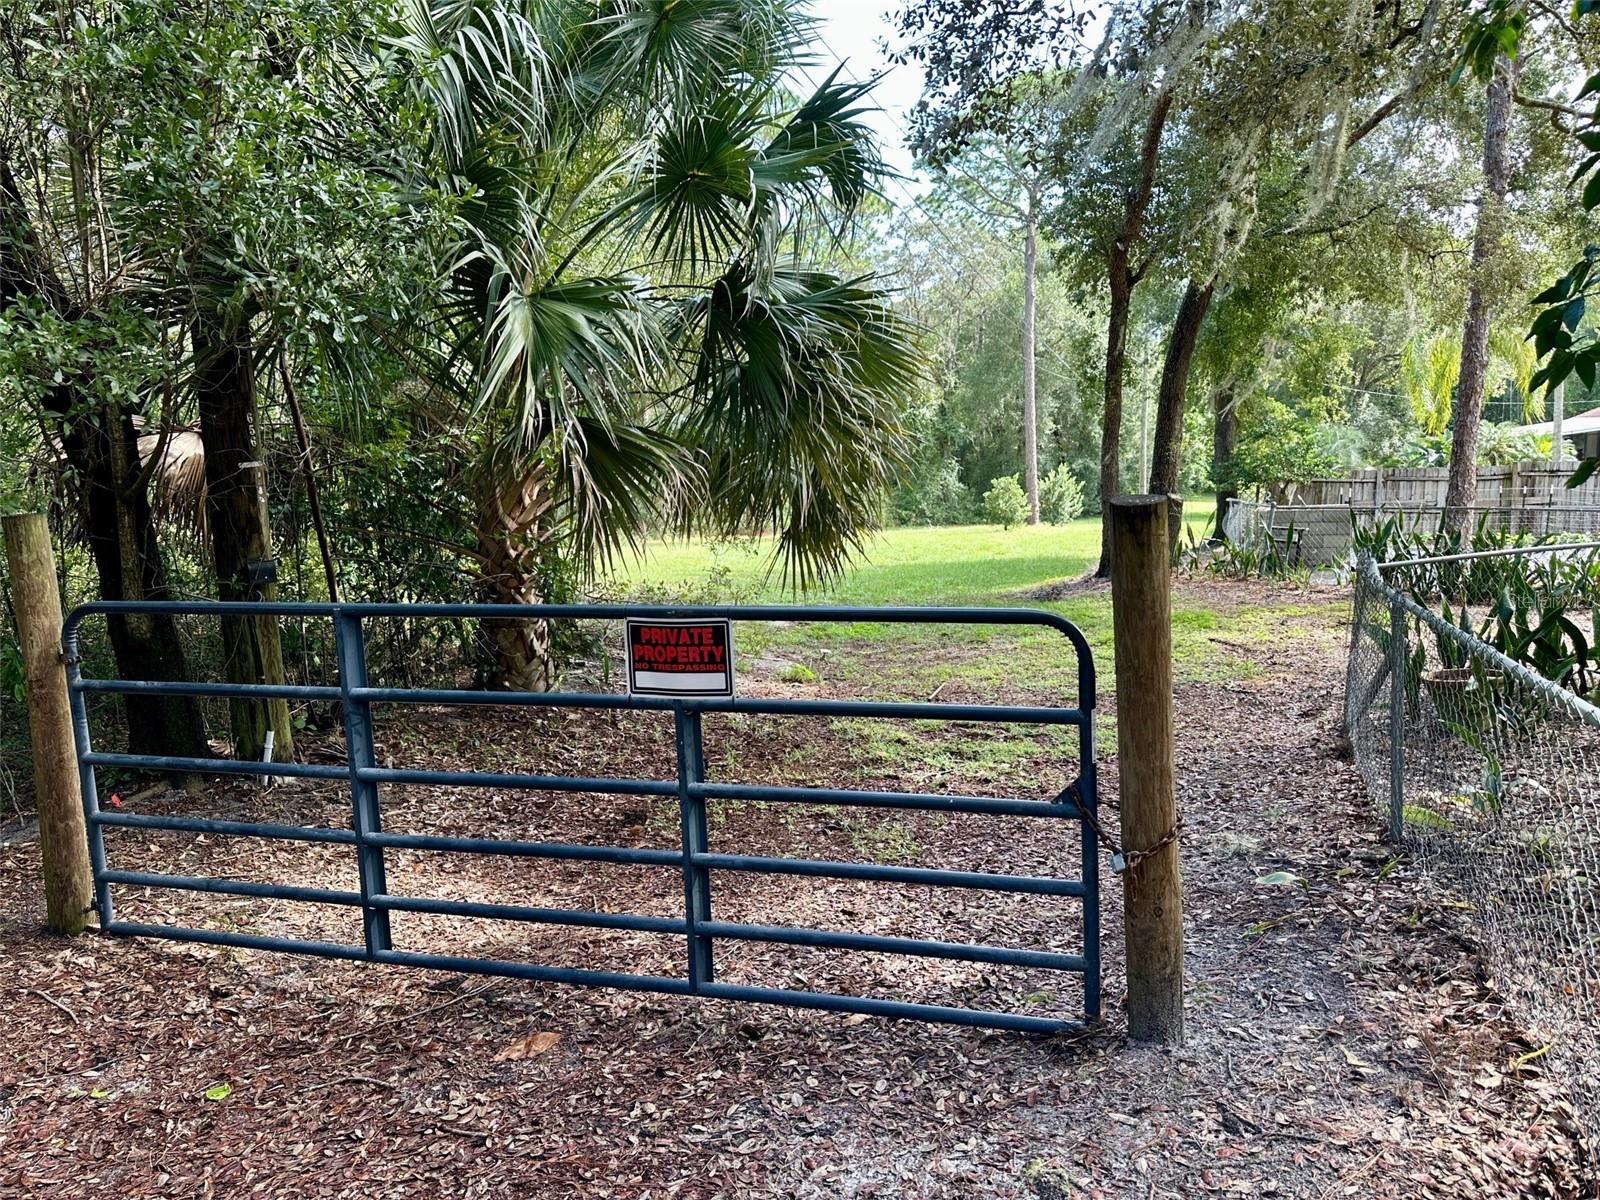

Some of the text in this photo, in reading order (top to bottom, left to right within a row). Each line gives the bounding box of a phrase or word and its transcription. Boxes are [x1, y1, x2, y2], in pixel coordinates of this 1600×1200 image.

[246, 412, 258, 447] 656
[640, 627, 714, 644] PRIVATE
[634, 644, 723, 662] PROPERTY
